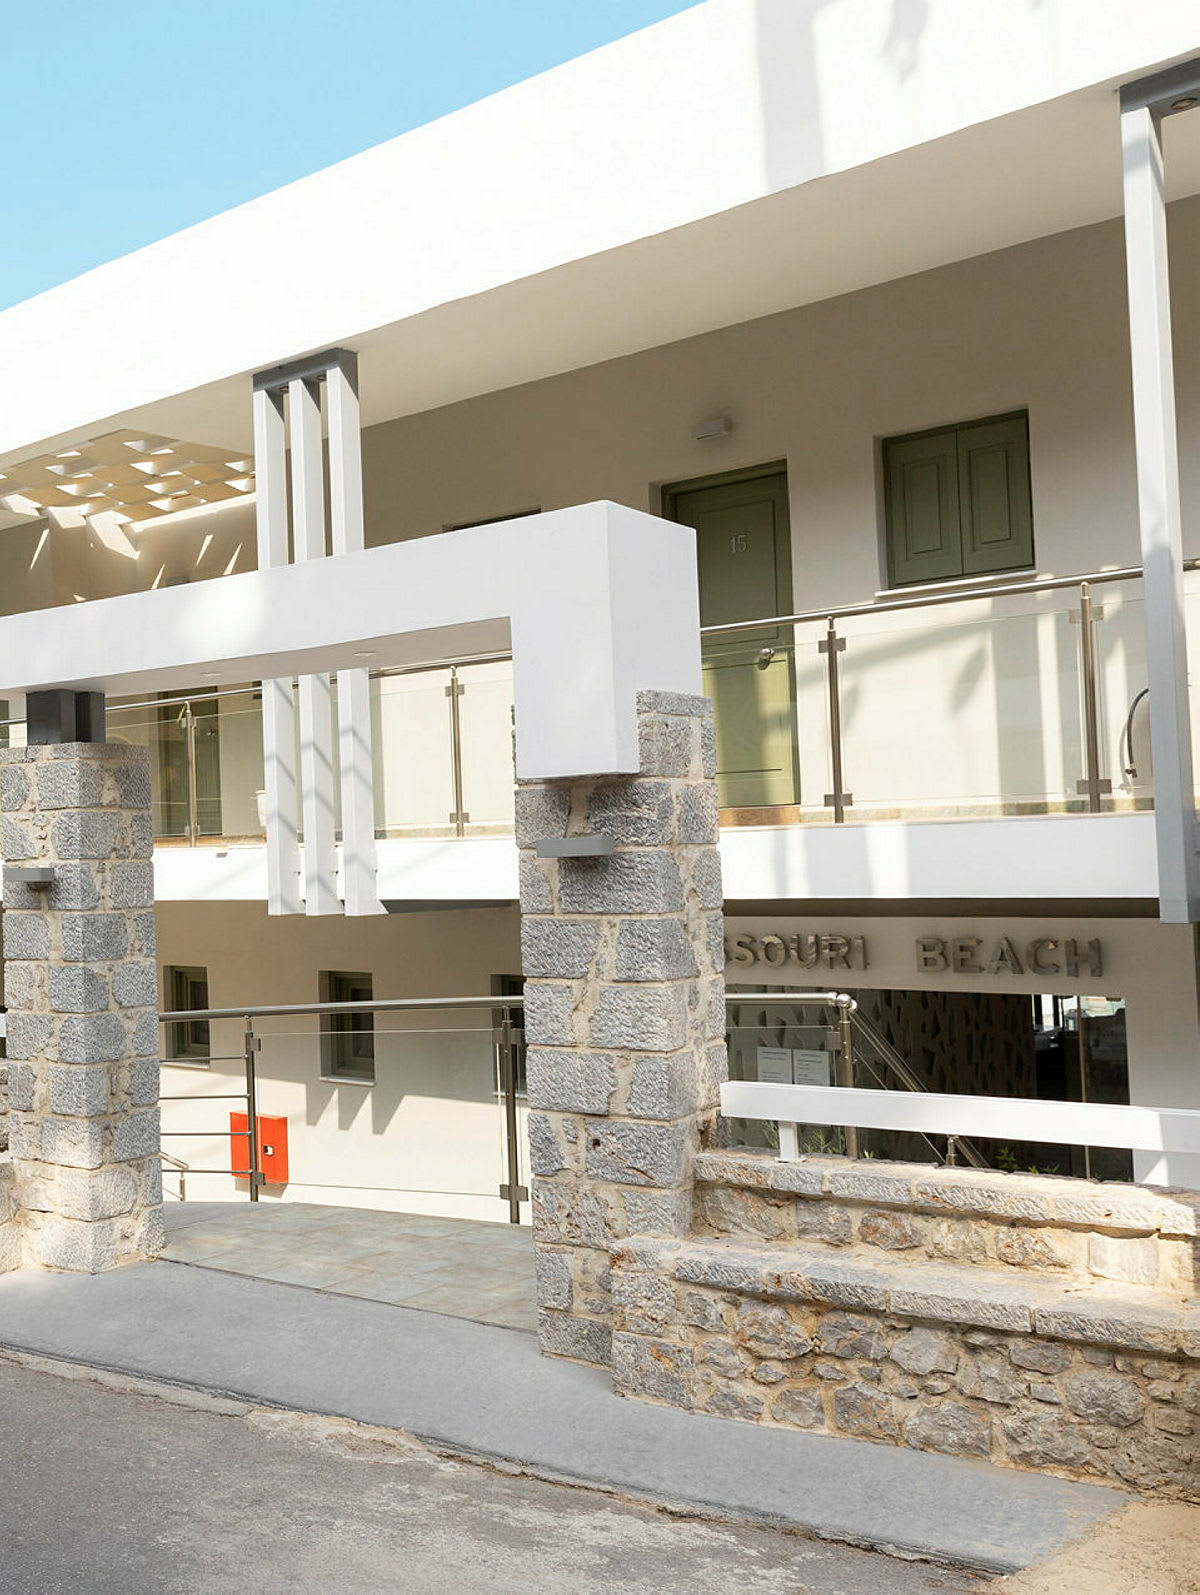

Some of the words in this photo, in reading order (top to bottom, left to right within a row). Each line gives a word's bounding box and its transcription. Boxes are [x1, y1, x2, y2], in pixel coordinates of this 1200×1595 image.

[731, 534, 747, 553] 15
[725, 933, 869, 970] SOURI
[915, 936, 1103, 977] BEACH
